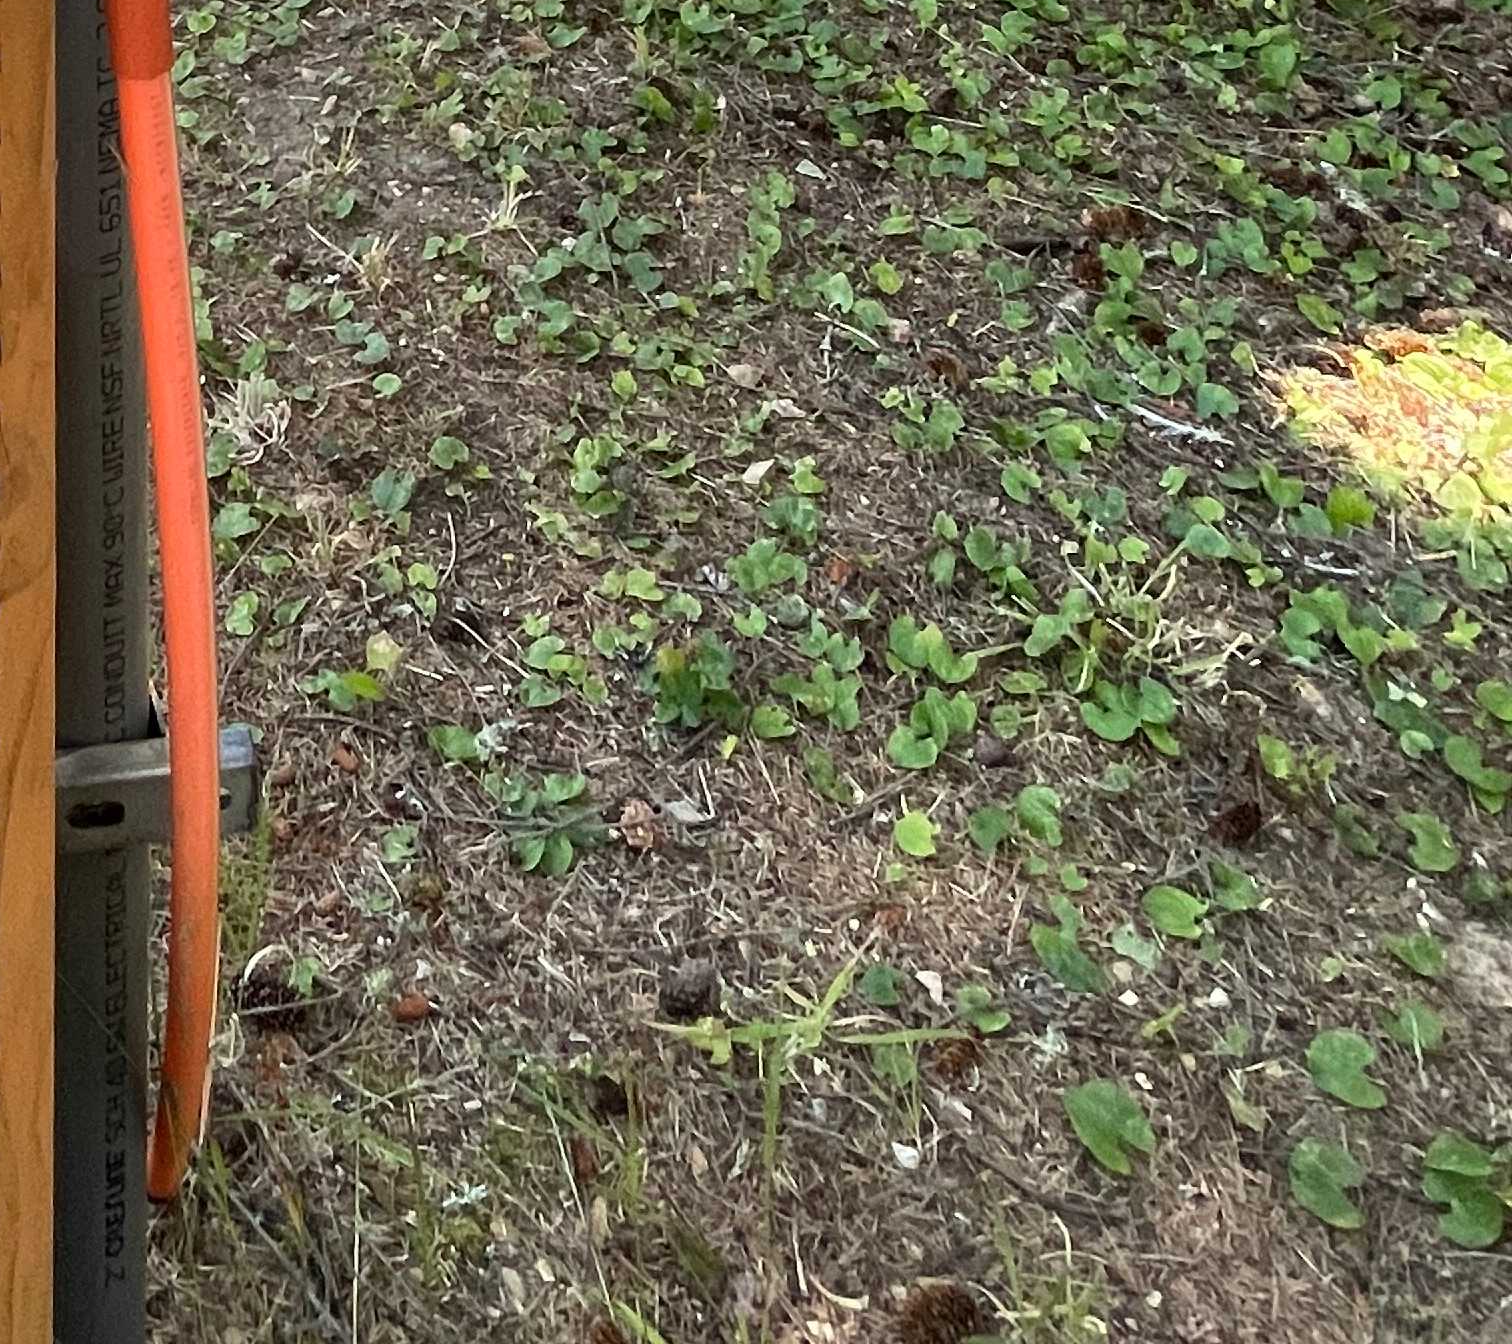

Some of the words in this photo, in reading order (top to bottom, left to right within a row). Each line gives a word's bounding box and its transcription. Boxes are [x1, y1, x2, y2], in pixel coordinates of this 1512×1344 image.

[96, 98, 121, 175] NEMA
[98, 180, 122, 233] 651
[99, 238, 123, 278] UL
[100, 283, 123, 357] NRTL
[101, 360, 124, 415] NSF
[102, 416, 125, 482] WIRE
